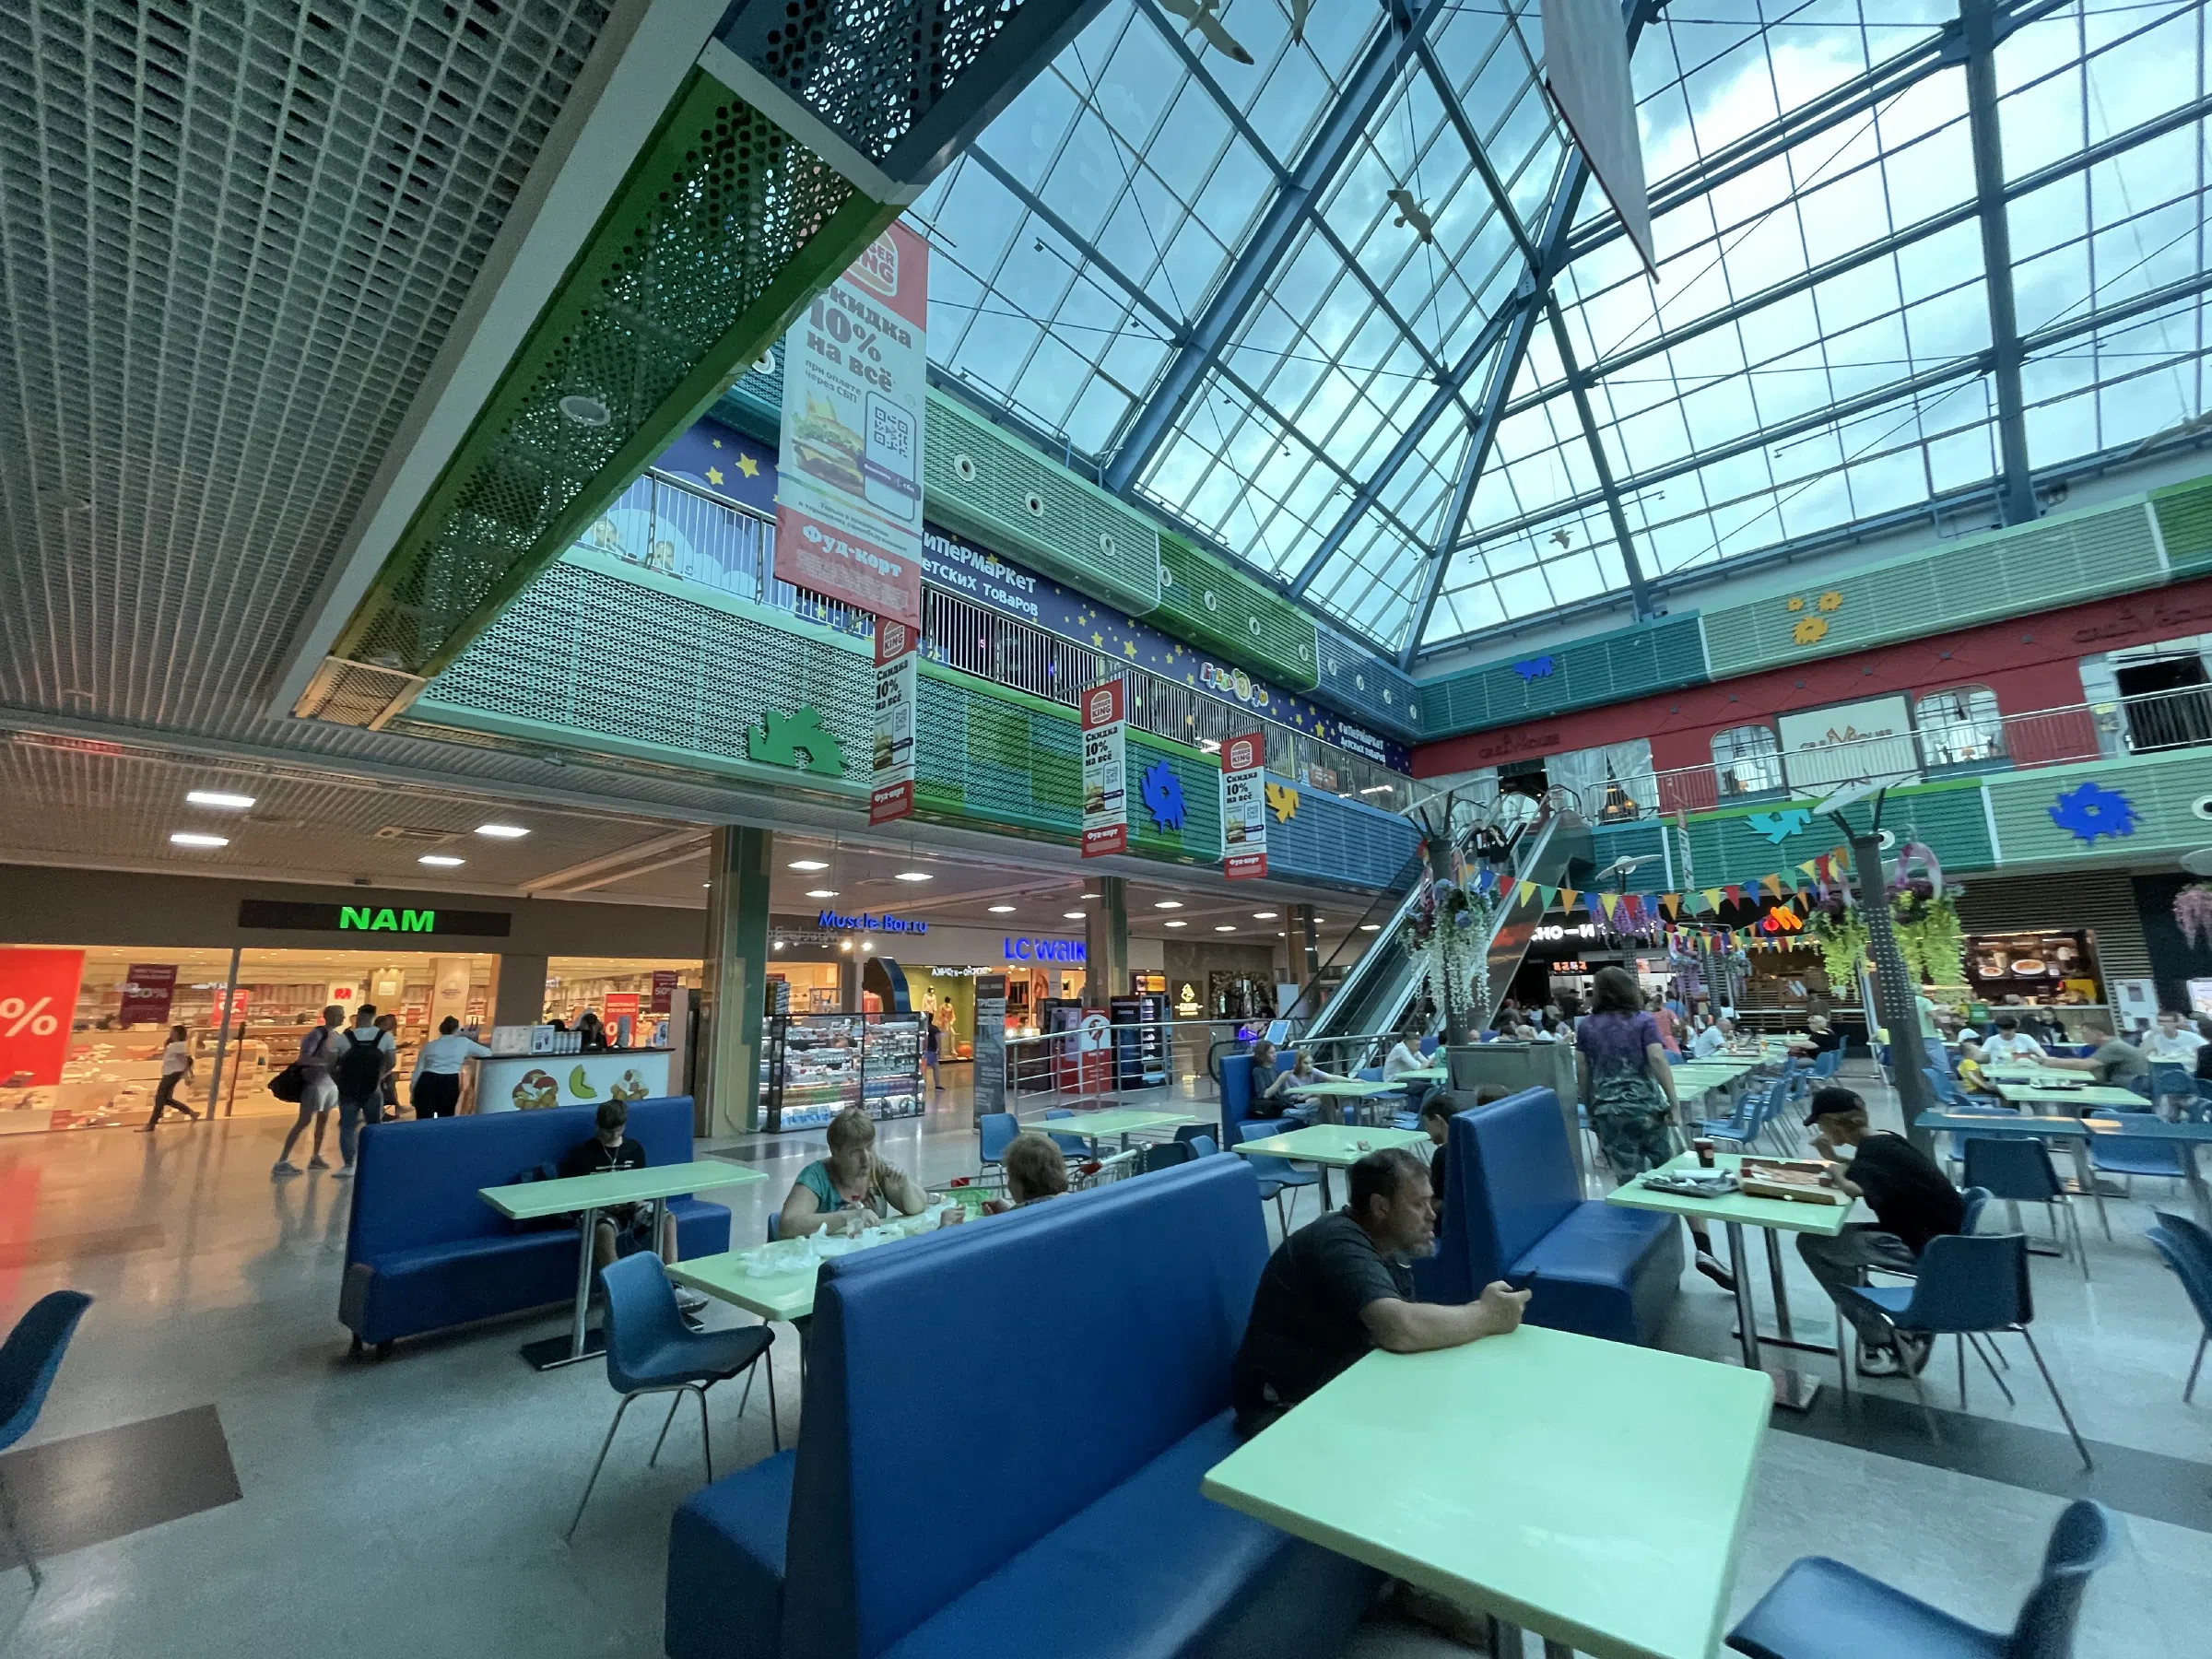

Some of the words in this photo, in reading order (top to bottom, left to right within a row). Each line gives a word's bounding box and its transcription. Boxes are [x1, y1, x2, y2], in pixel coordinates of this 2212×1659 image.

[828, 283, 912, 349] кидка
[809, 297, 882, 362] 10%
[806, 330, 842, 366] на
[805, 369, 835, 393] через
[836, 386, 857, 404] СБП
[806, 359, 826, 375] при
[826, 371, 862, 394] оплате
[802, 524, 902, 578] Фуд-корт
[923, 528, 1036, 594] ипермаркет
[922, 558, 977, 591] етских
[982, 582, 1039, 617] товаров
[884, 633, 903, 650] KING
[877, 659, 909, 682] Скидка
[876, 677, 899, 700] 10%
[875, 700, 887, 712] на
[1091, 705, 1112, 719] KING
[1085, 726, 1118, 743] Скидка
[1085, 740, 1109, 758] 10%
[1231, 754, 1251, 763] KING
[1085, 757, 1097, 767] на
[1226, 771, 1258, 783] Скидка
[1226, 782, 1249, 796] 10%
[1226, 796, 1237, 805] на
[339, 906, 435, 933] NAM
[1004, 935, 1031, 961] LC
